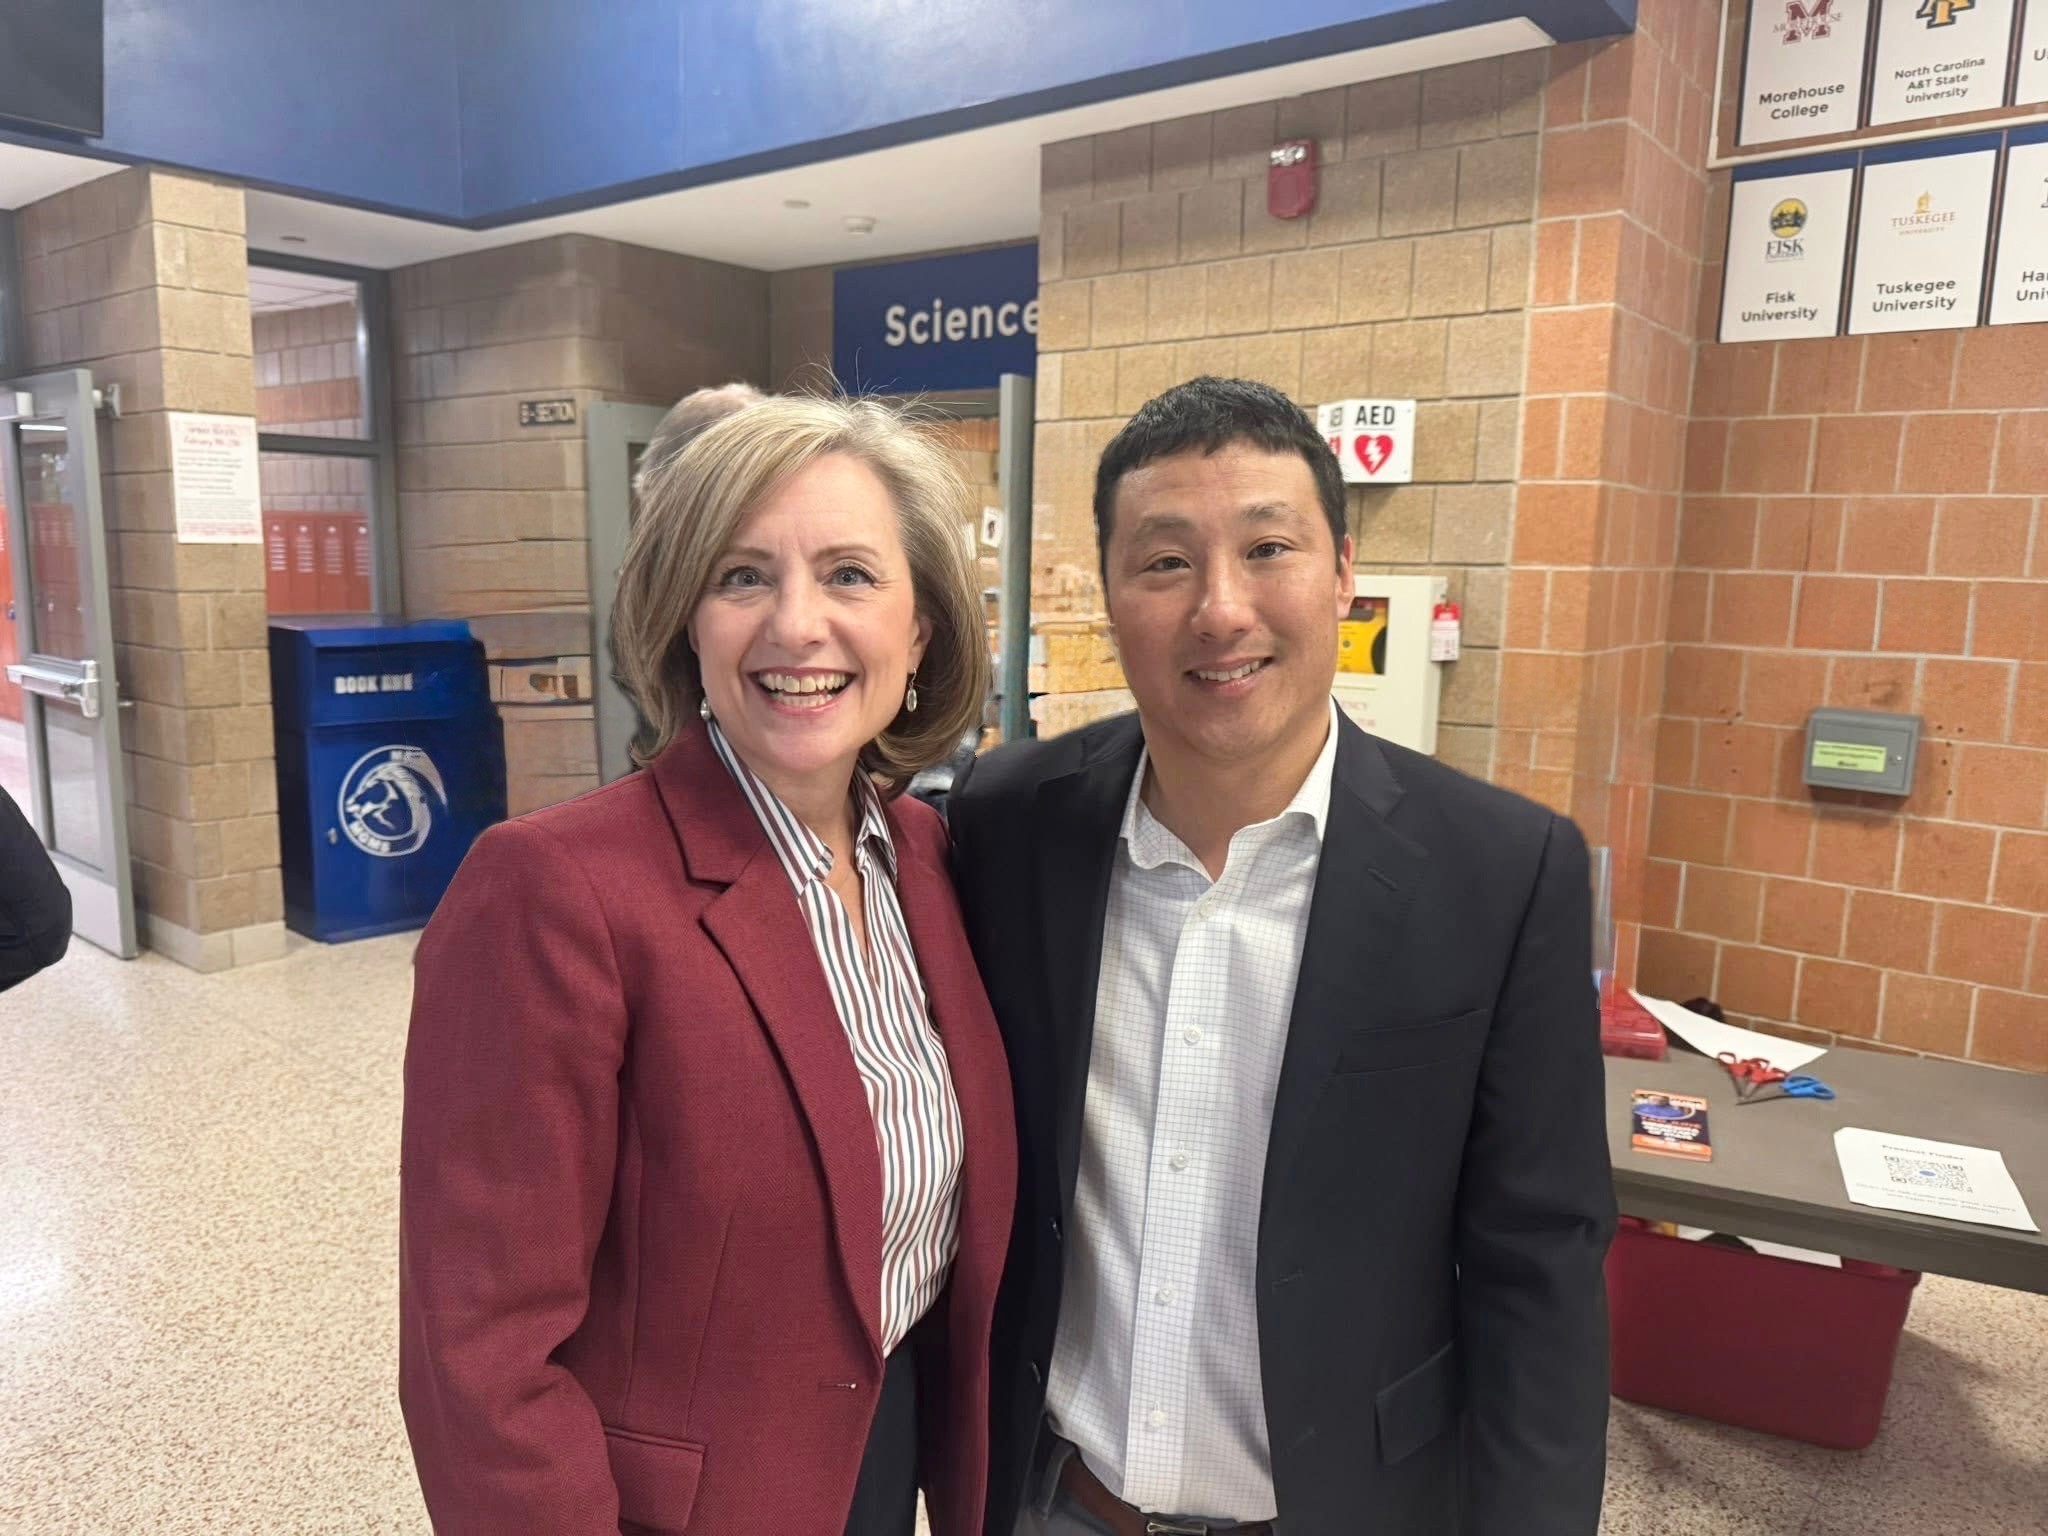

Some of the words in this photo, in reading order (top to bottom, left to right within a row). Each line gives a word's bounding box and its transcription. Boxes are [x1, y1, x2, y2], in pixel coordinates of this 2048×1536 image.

[1894, 65, 1930, 80] North
[1933, 57, 1986, 74] Carolina
[1907, 78, 1932, 91] A&T
[1935, 73, 1969, 87] State
[1758, 83, 1845, 105] Morehouse
[1905, 87, 1969, 104] University
[1770, 104, 1829, 120] College
[1891, 211, 1957, 227] TUSKEGEE
[1766, 239, 1804, 255] FISK
[1876, 280, 1957, 295] Tuskegee
[1766, 291, 1796, 304] Fisk
[1872, 296, 1957, 313] University
[885, 298, 1038, 347] Science
[1741, 307, 1818, 323] University
[1355, 405, 1395, 426] AED
